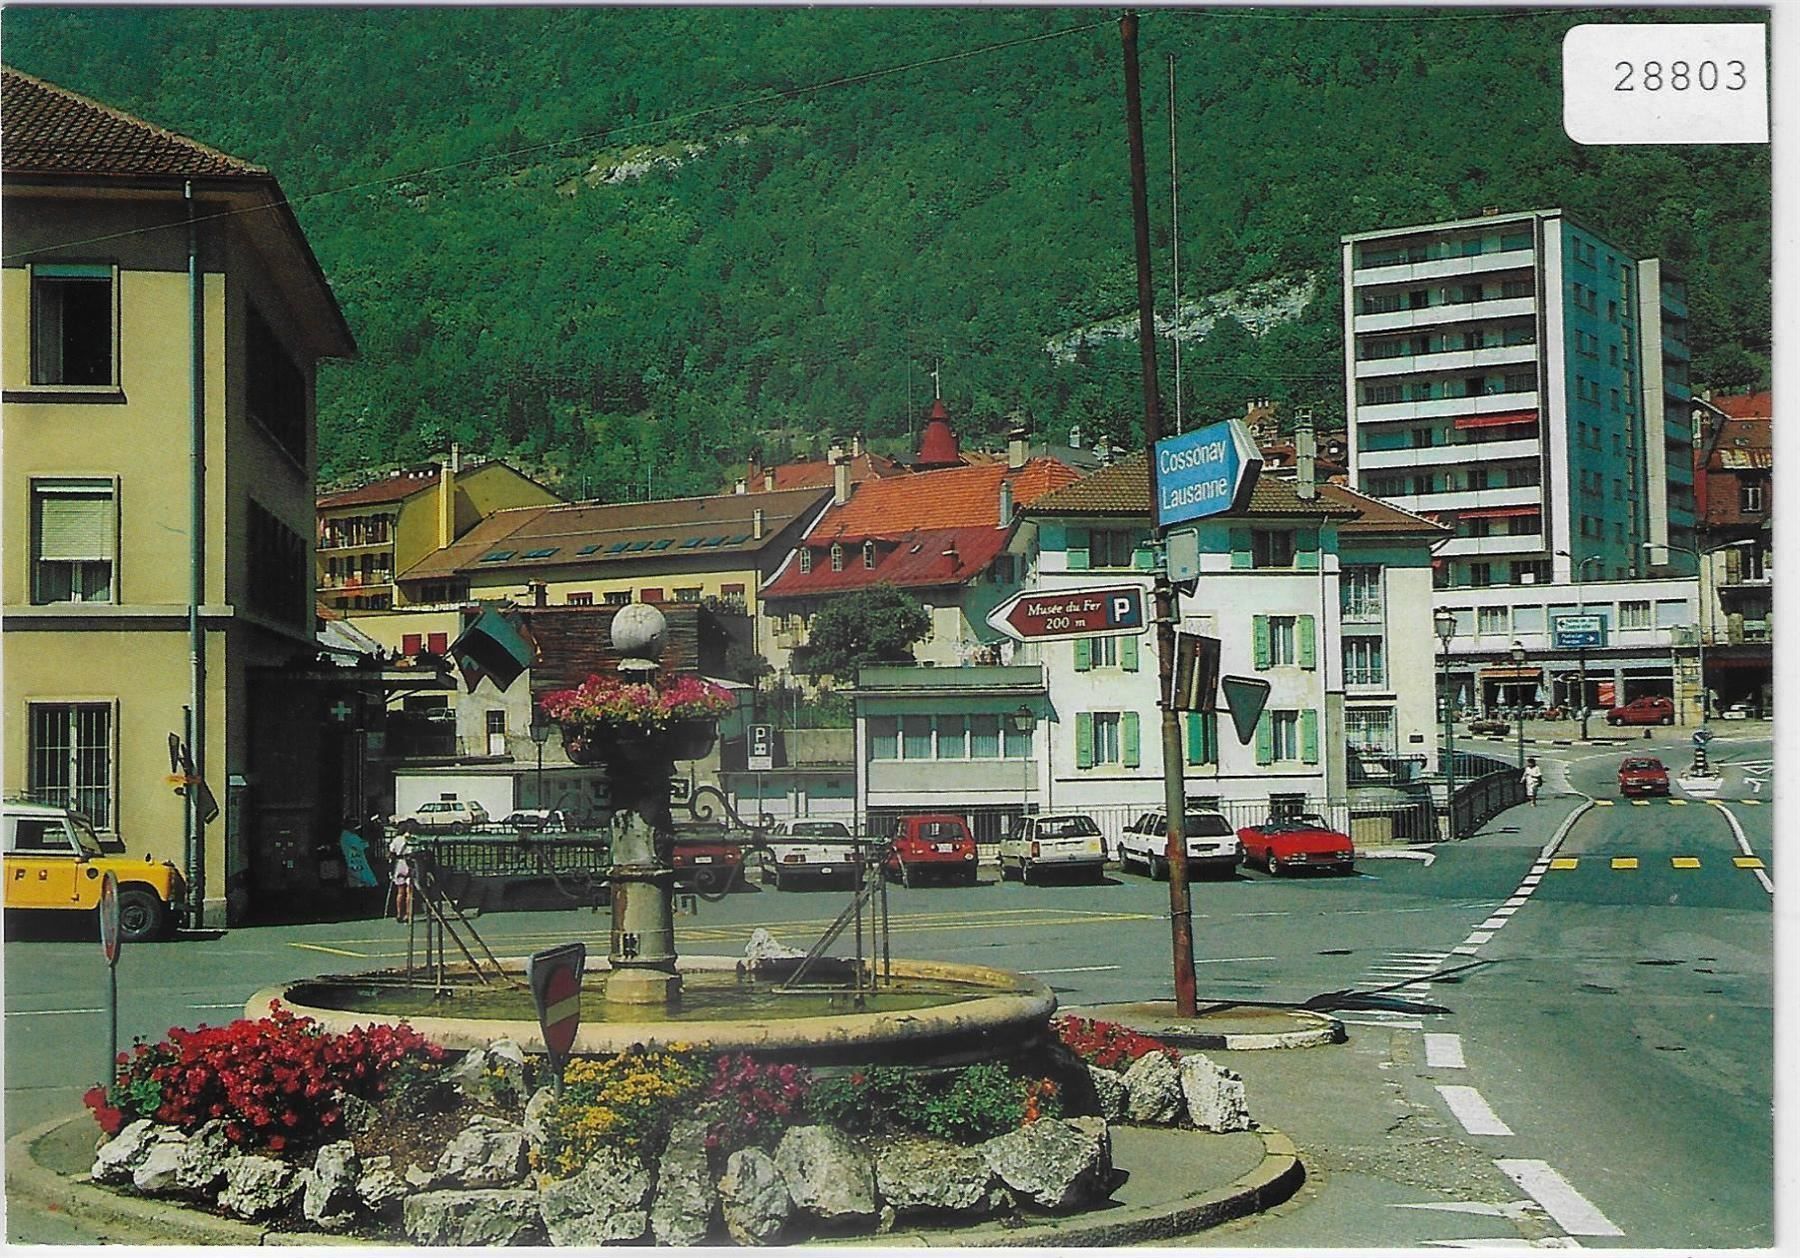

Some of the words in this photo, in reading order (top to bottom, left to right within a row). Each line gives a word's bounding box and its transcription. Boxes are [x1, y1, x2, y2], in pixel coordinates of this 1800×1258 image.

[1160, 440, 1227, 474] Cossonay
[1162, 478, 1228, 510] Lausanne
[1065, 601, 1081, 613] du
[1083, 599, 1102, 612] Fer
[1113, 598, 1130, 622] P
[1046, 616, 1070, 630] 200
[1075, 619, 1086, 627] m
[755, 727, 766, 743] P
